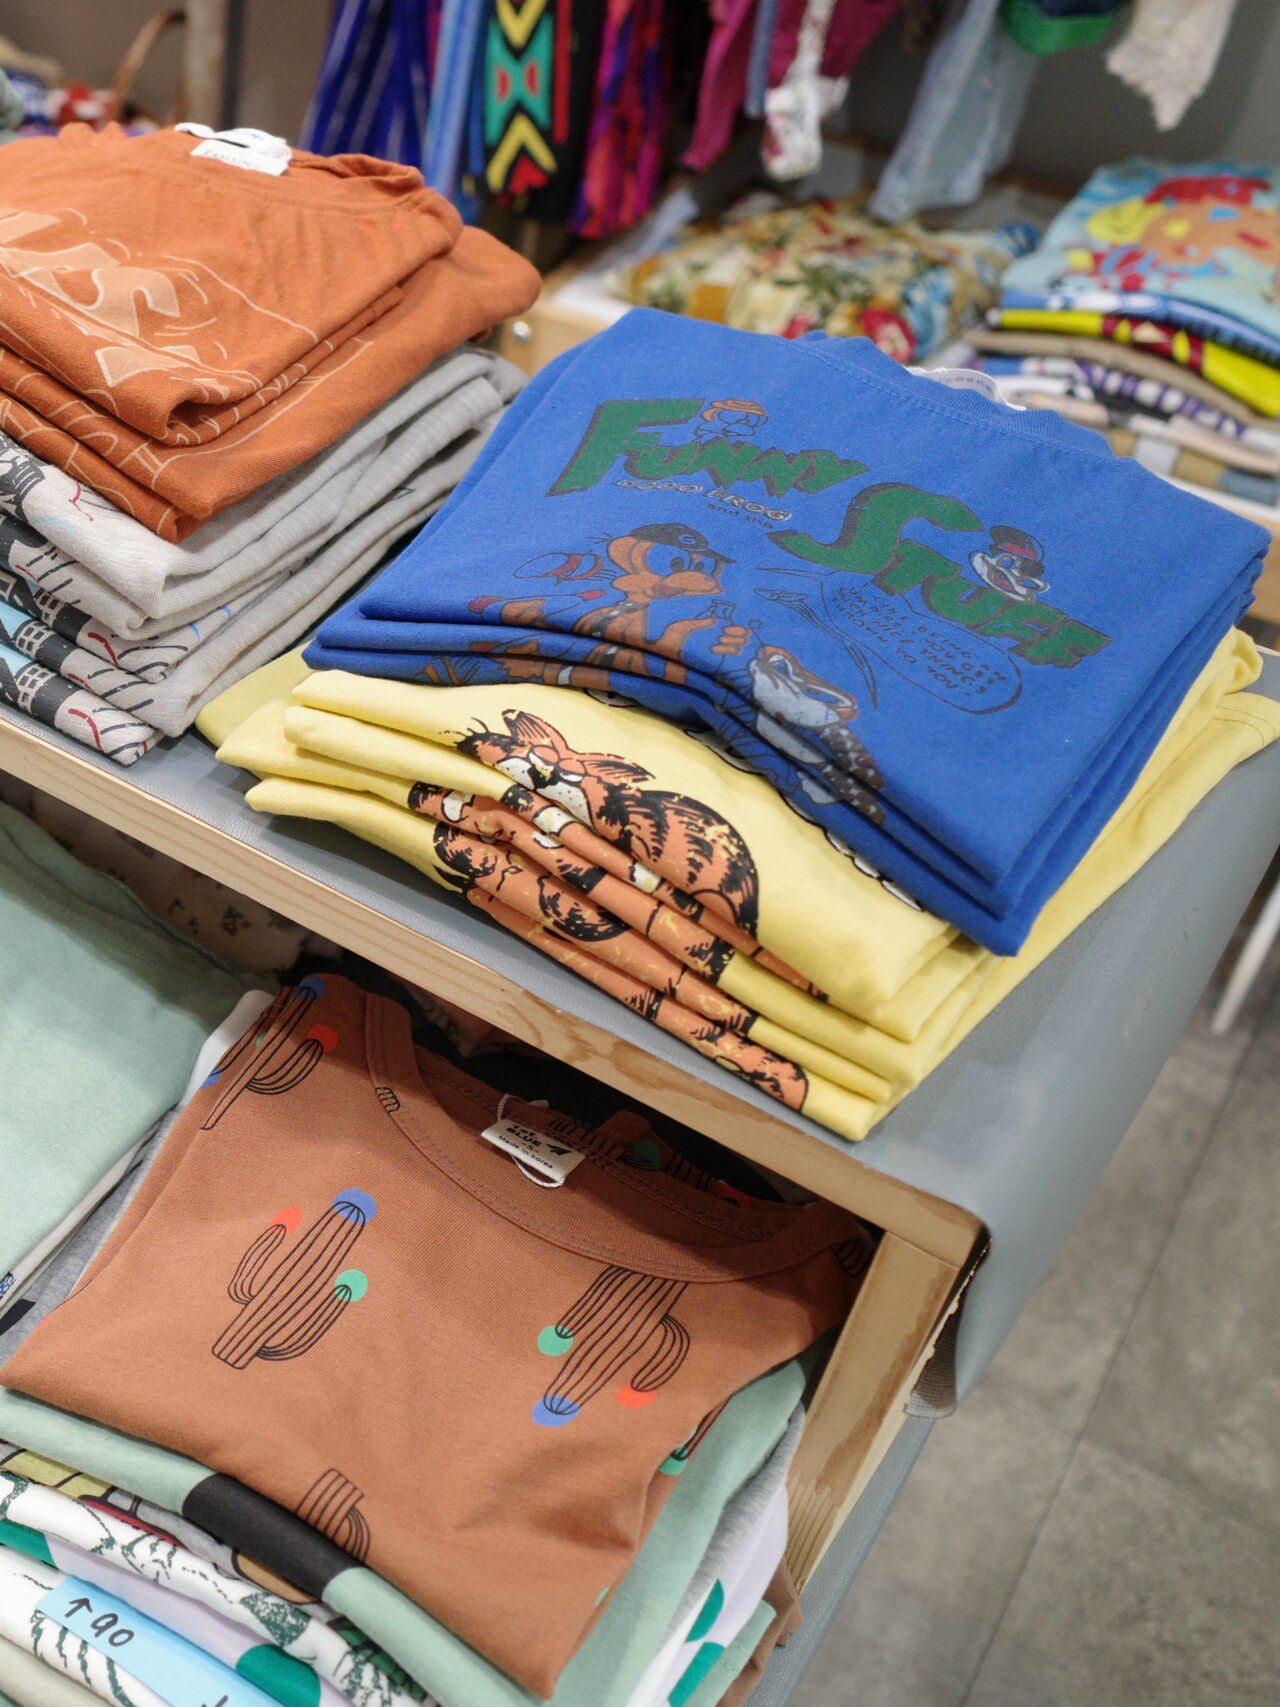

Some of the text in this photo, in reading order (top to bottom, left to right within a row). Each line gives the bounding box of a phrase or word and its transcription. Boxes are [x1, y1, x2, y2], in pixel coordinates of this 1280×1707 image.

[701, 489, 793, 522] FROG
[706, 503, 774, 530] and the
[896, 648, 918, 665] TO
[497, 1135, 520, 1149] Made
[505, 1127, 543, 1147] BLUE
[89, 1614, 135, 1649] 90
